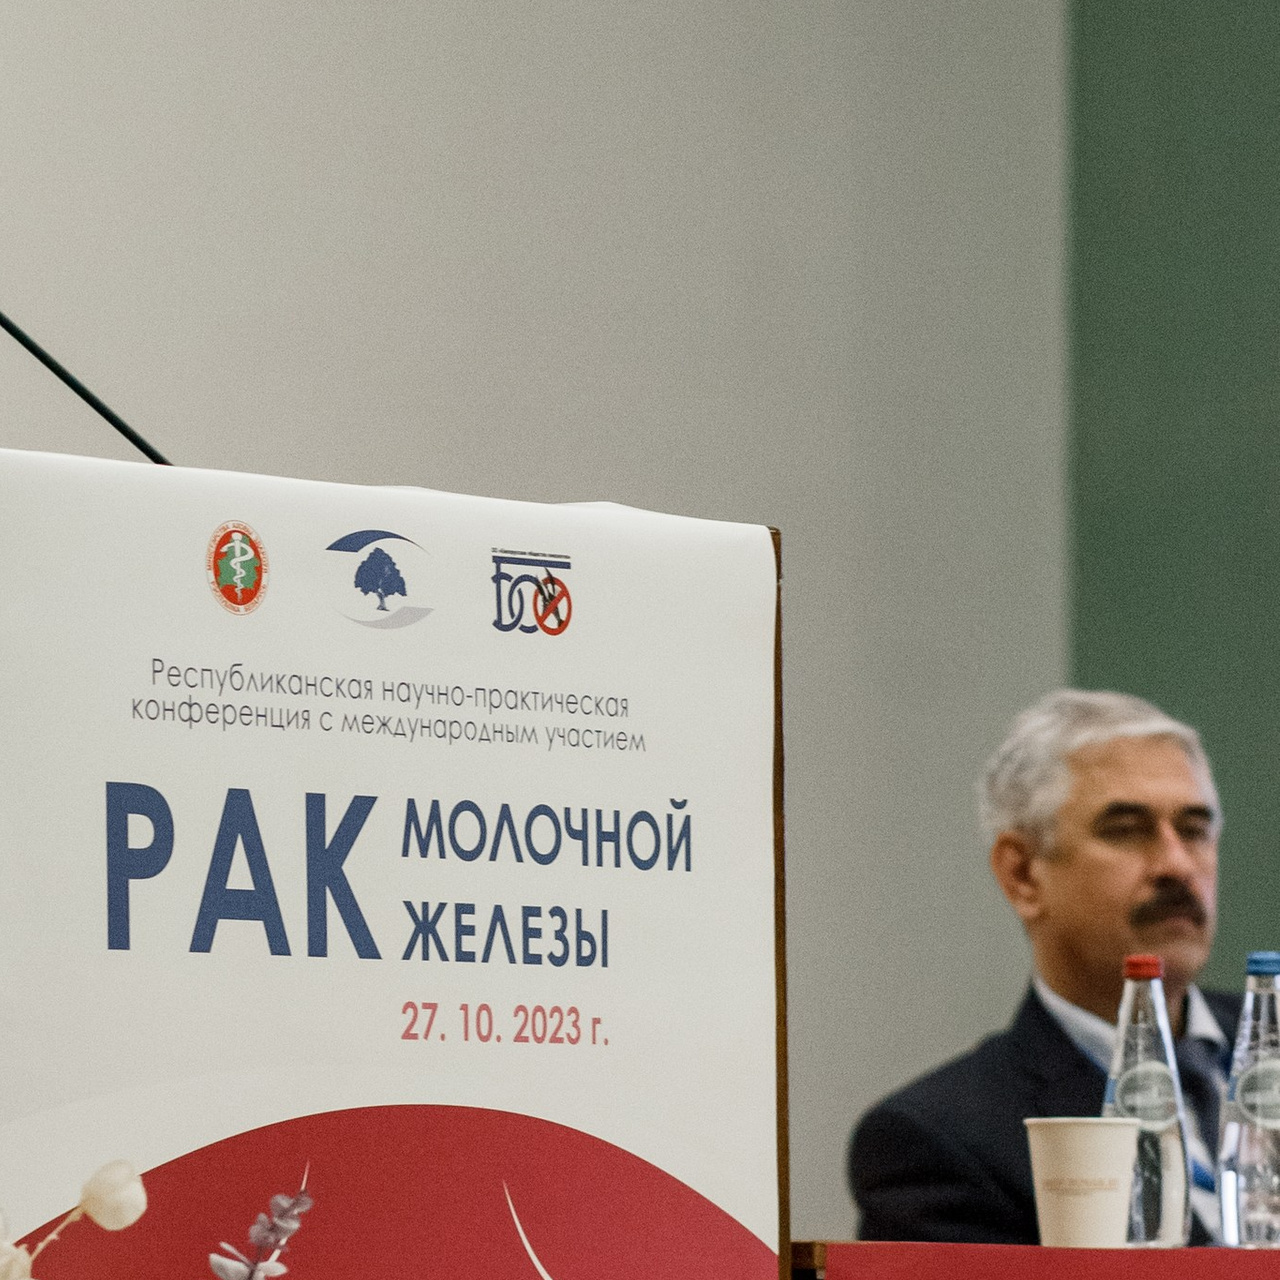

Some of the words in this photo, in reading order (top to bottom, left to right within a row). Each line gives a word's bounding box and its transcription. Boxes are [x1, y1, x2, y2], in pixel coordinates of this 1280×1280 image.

[151, 657, 373, 700] Республиканская
[382, 679, 629, 718] научно-практическая
[131, 693, 311, 732] конференция
[319, 710, 333, 732] с
[341, 712, 539, 746] международным
[545, 726, 646, 752] участием
[401, 797, 693, 872] МОЛОЧНОЙ
[105, 781, 383, 960] РАК
[401, 900, 609, 968] ЖЕЛЕЗЫ
[401, 1001, 447, 1042] 27.
[459, 1003, 502, 1044] 10.
[513, 1004, 582, 1046] 2023
[591, 1016, 610, 1047] г.
